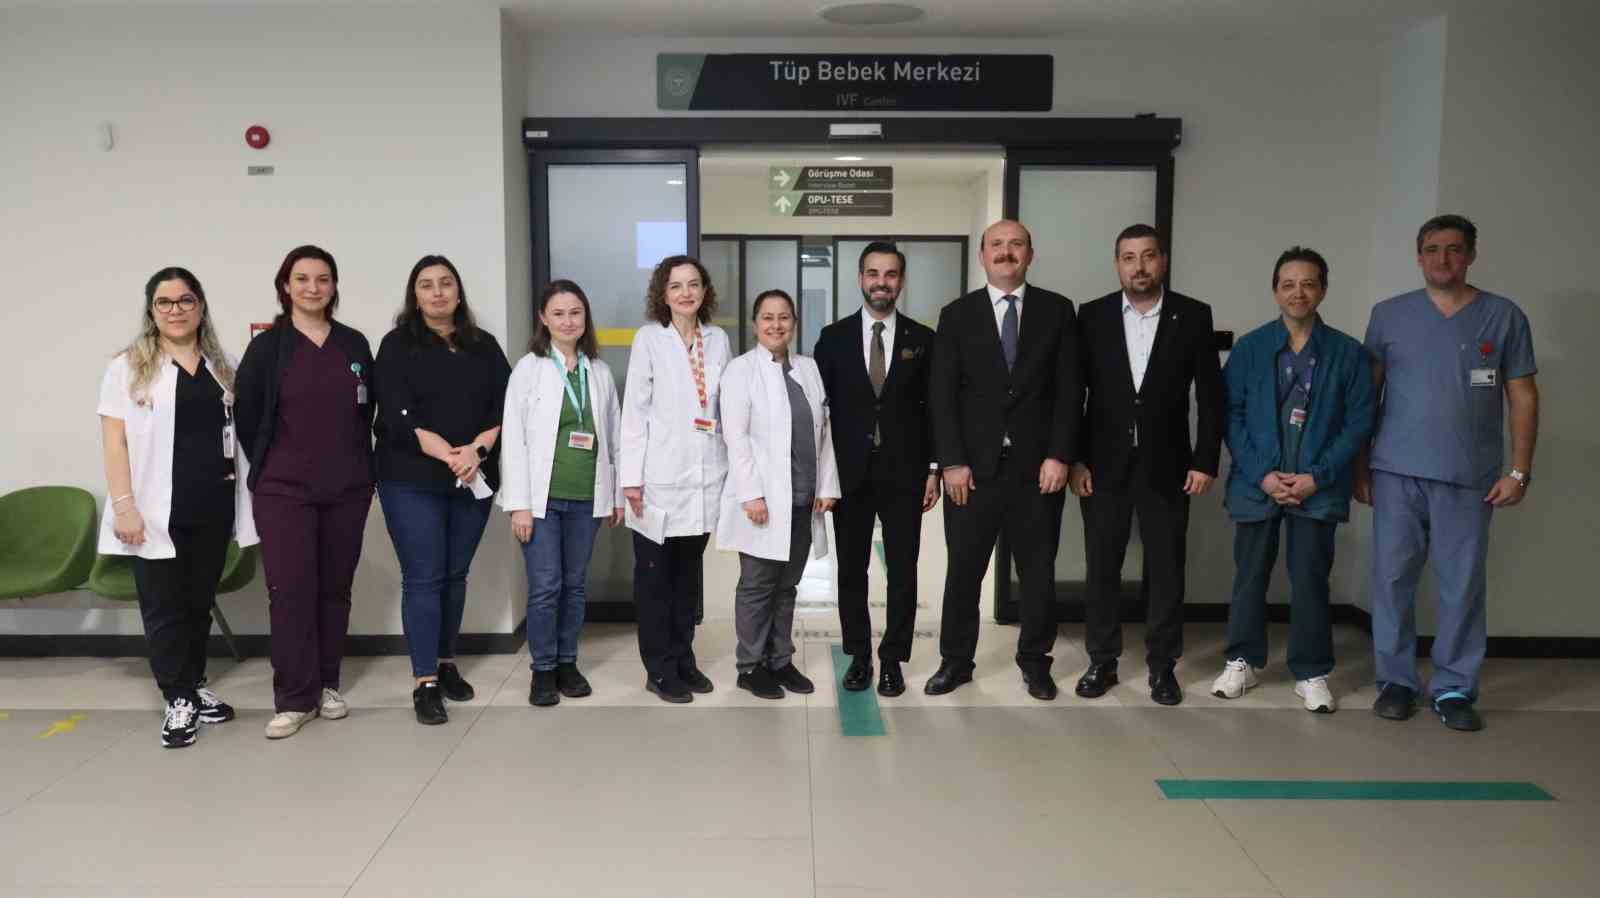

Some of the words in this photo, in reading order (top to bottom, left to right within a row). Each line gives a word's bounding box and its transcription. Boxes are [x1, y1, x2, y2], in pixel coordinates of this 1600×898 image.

[769, 60, 811, 84] Tüp
[817, 60, 887, 81] Bebek
[893, 60, 981, 81] Merkezi
[836, 93, 859, 107] IVF
[808, 168, 847, 180] Görüşme
[849, 168, 874, 178] Odası
[808, 194, 854, 204] OPU-TESE
